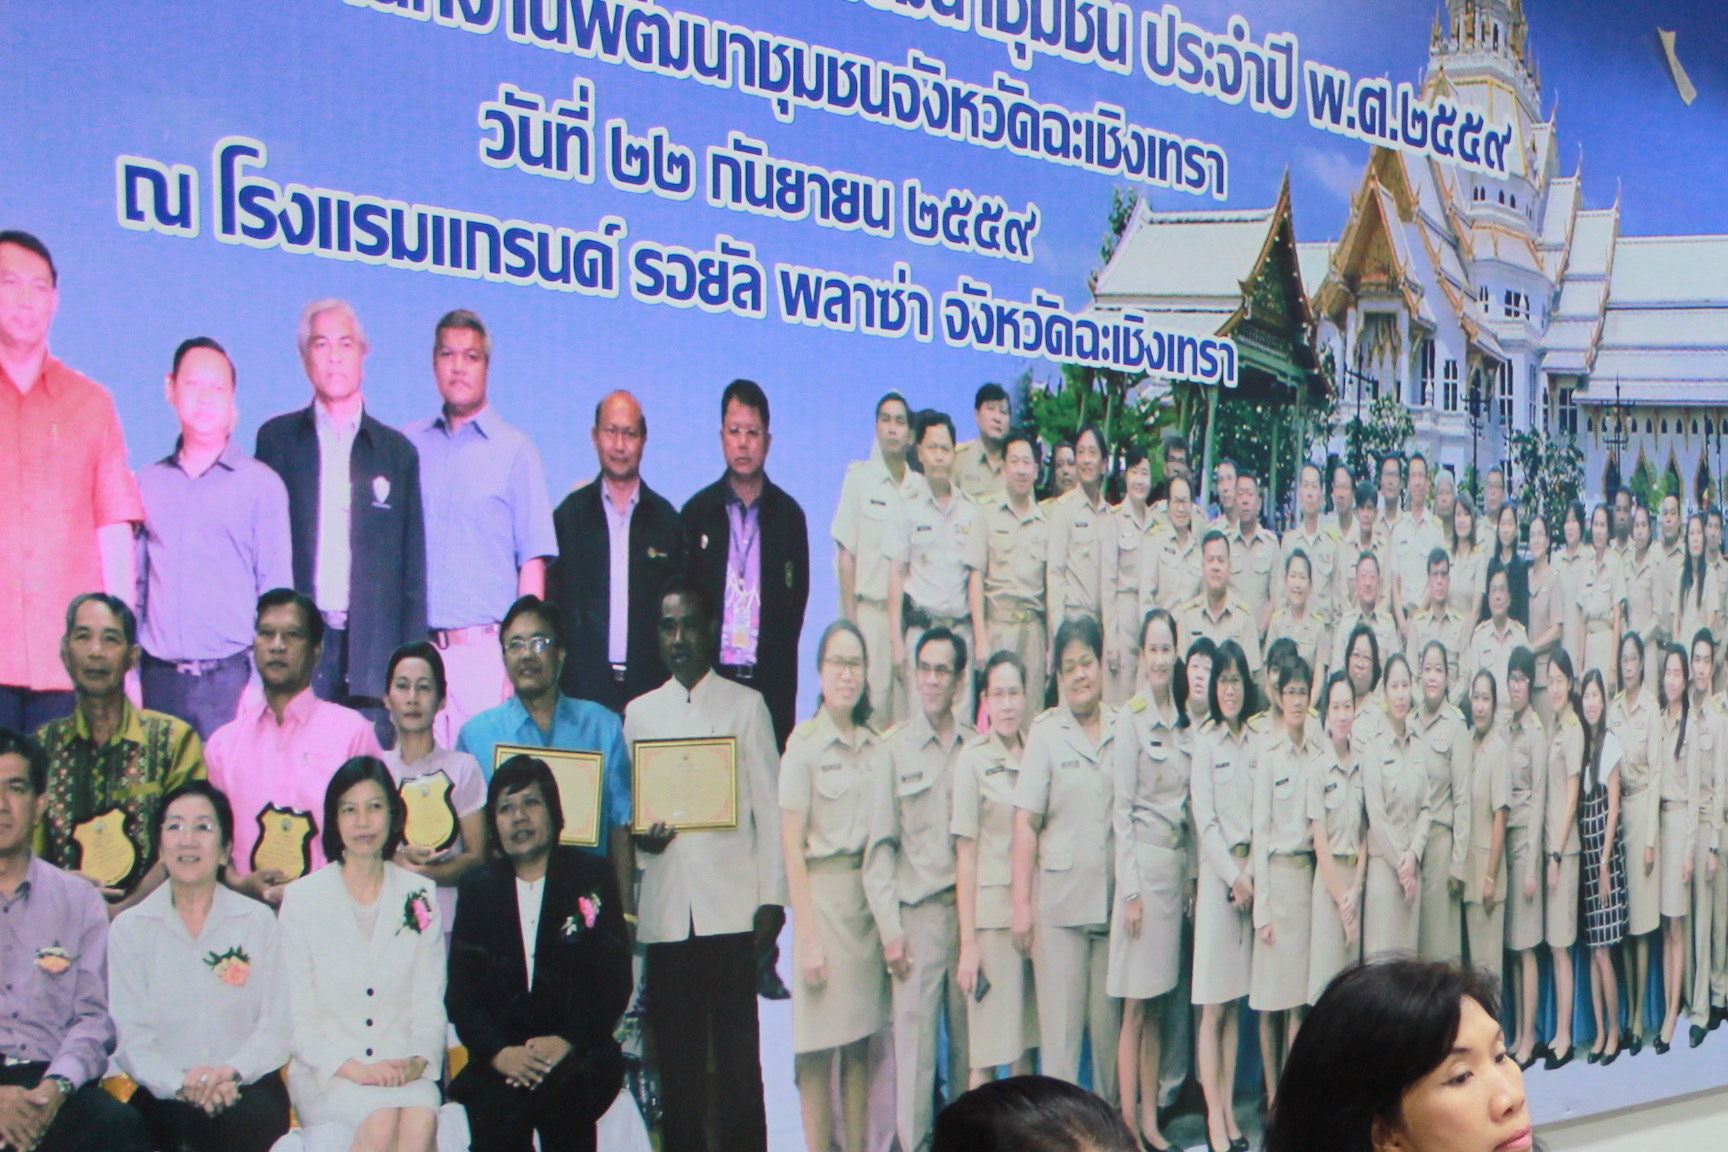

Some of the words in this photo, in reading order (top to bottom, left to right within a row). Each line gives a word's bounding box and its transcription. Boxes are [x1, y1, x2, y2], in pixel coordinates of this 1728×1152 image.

[484, 84, 588, 175] วันที่
[611, 127, 690, 192] ๒๒
[712, 139, 890, 230] กันยายน
[908, 186, 1036, 256] ๒๕๕๙
[896, 0, 1128, 65] าชุมชน
[1146, 13, 1293, 110] ประจำปี
[1308, 69, 1512, 172] พ.ศ.๒๕๕๙
[125, 165, 190, 228] ณ
[219, 145, 621, 290] โรงแรมแกรนด์
[634, 242, 761, 311] รอยัล
[780, 269, 928, 335] พลาซ่า
[945, 283, 1234, 381] จังหวัดฉะเชิงเทรา
